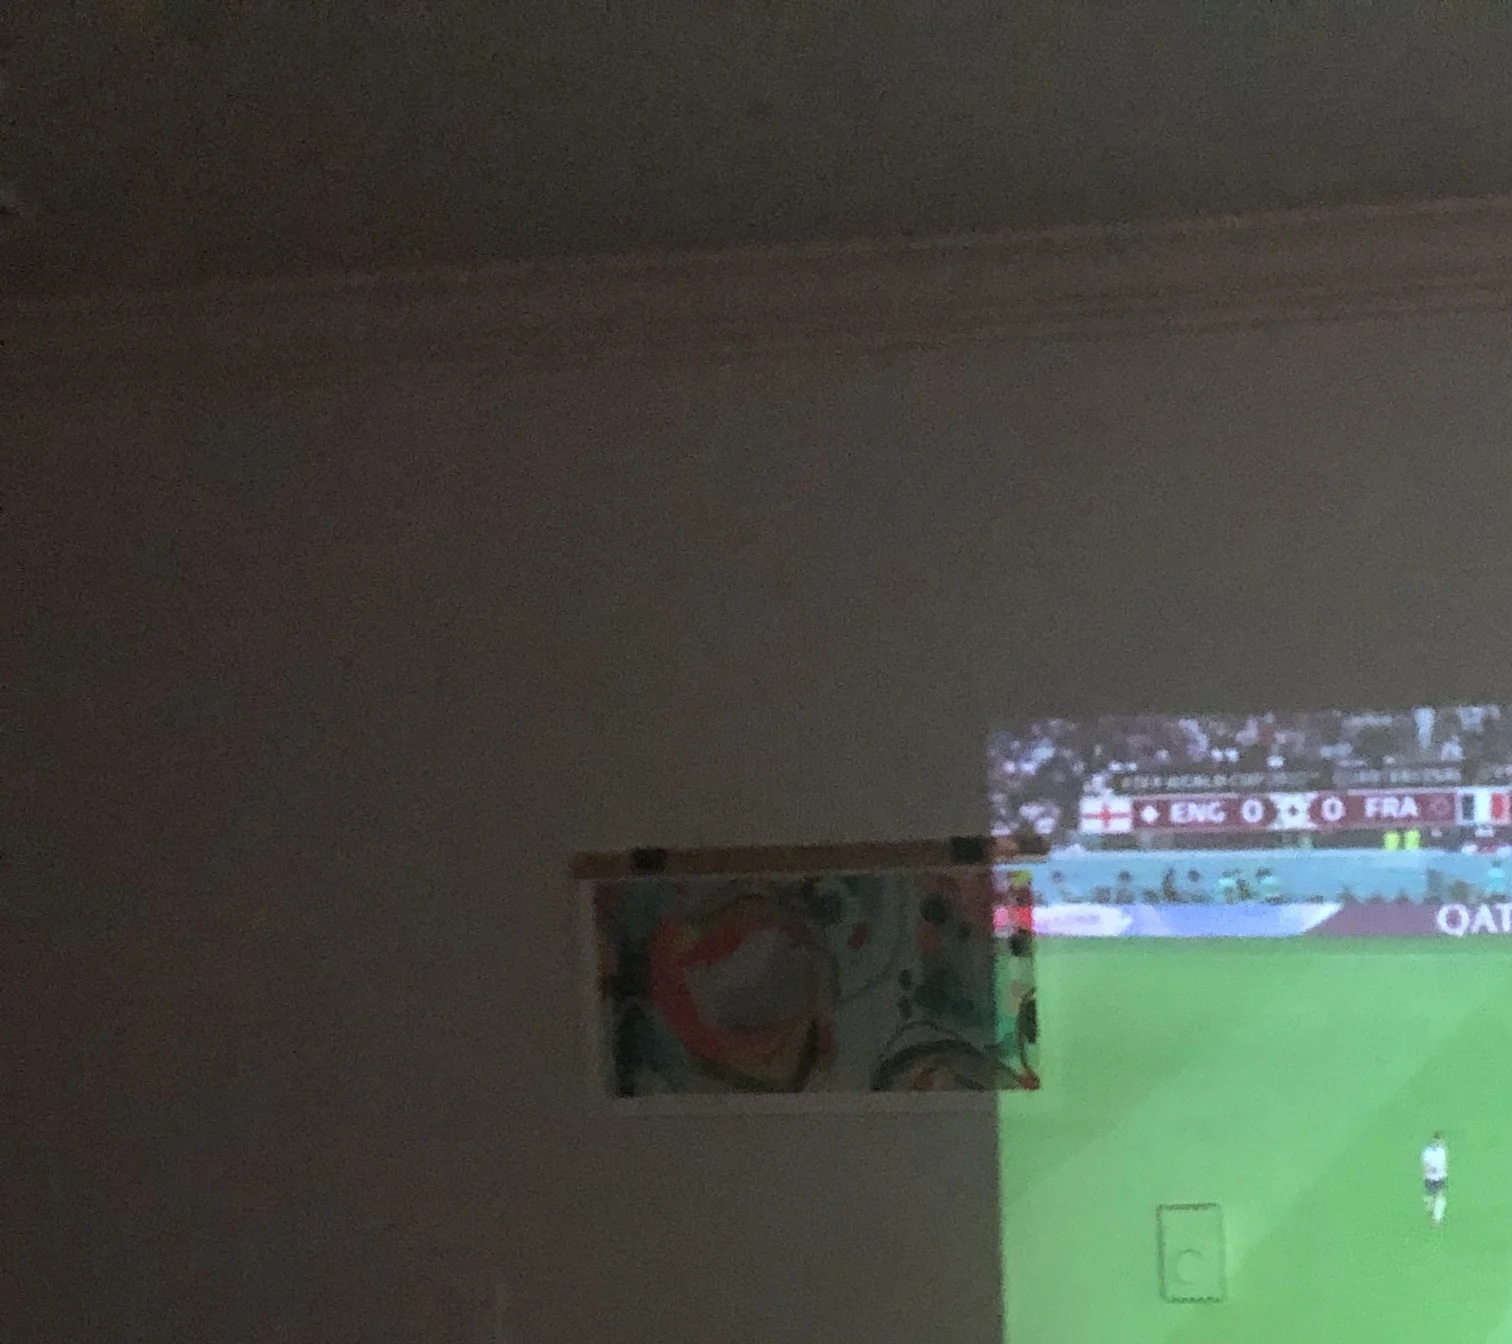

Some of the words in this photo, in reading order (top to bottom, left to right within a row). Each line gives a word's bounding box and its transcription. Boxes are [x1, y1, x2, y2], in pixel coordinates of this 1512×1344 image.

[1169, 801, 1228, 824] ENG
[1241, 800, 1264, 824] 0
[1321, 797, 1345, 822] 0
[1364, 796, 1418, 818] FRA
